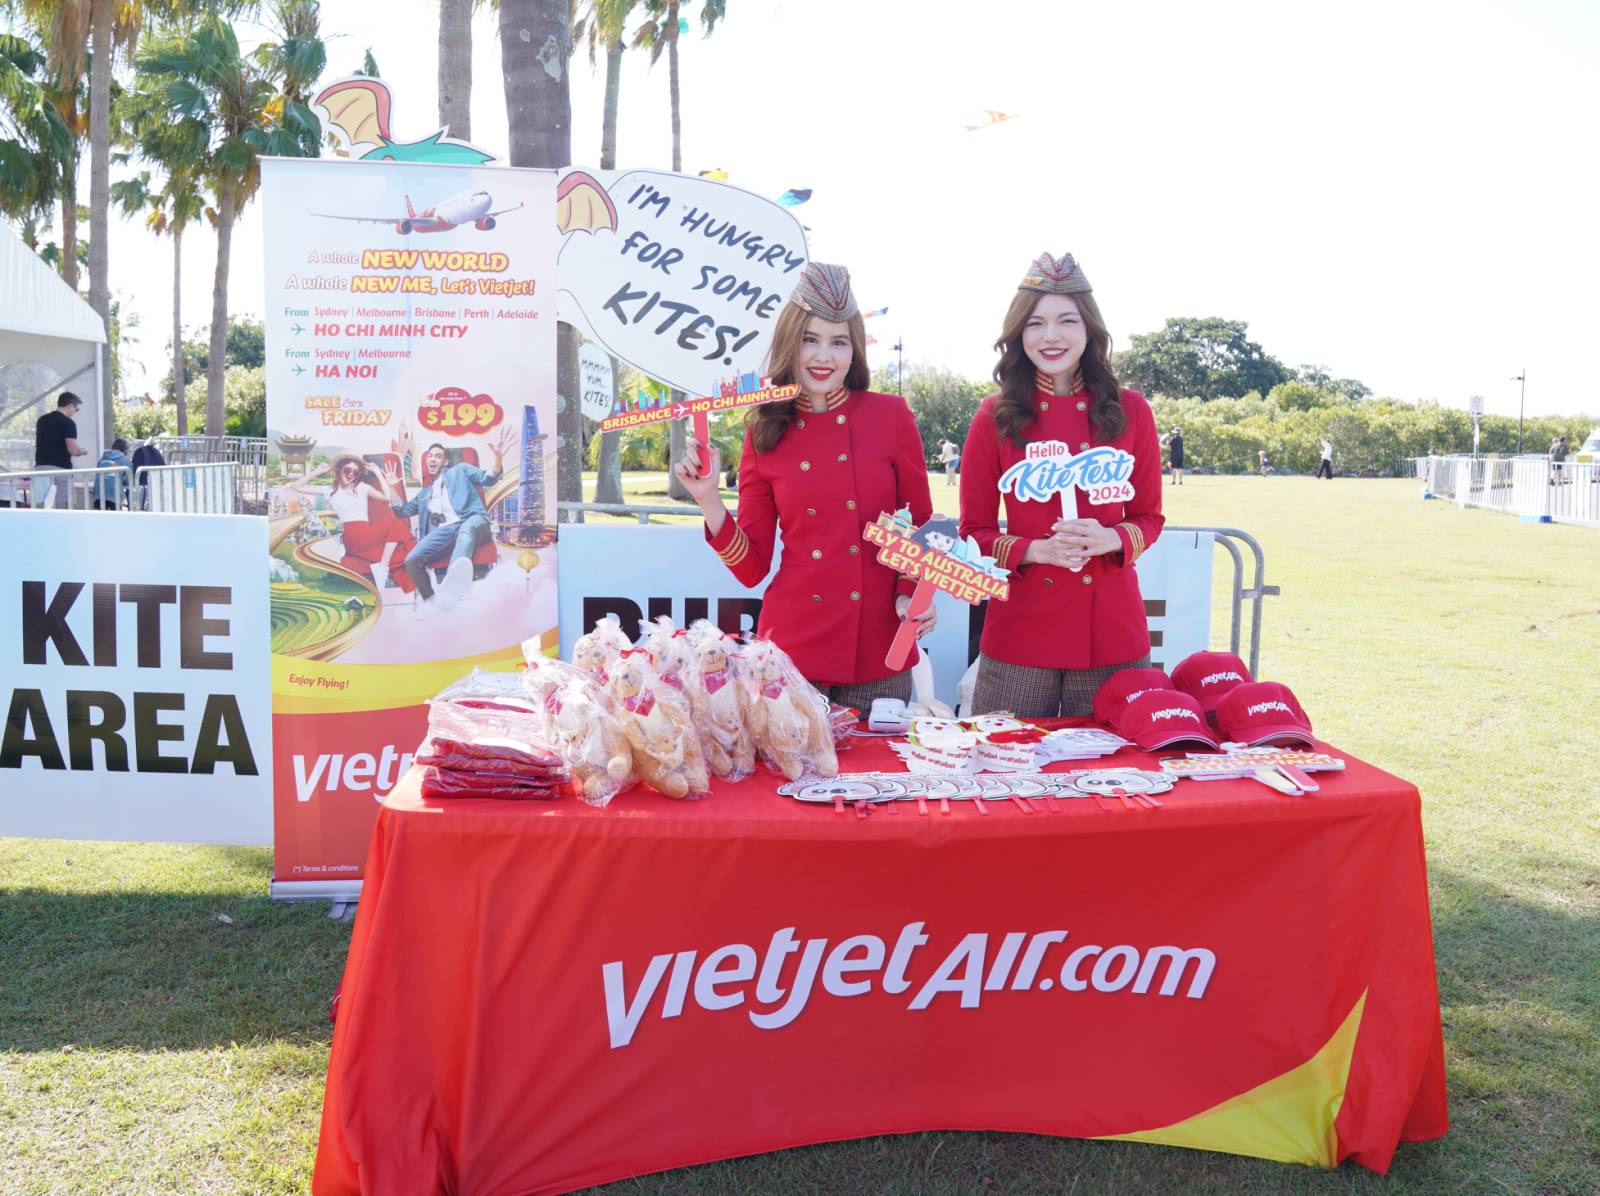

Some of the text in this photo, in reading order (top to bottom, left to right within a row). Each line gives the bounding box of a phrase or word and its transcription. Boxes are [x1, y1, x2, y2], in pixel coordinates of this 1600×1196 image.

[627, 184, 805, 274] I'M HUNGRY
[308, 249, 510, 272] A whole NEW WORLD
[286, 274, 536, 298] A whole NEW ME, Let's Vietjet!
[621, 231, 781, 319] FOR SOME
[284, 307, 539, 320] From Sydney Melbourne Brisbane Perth Adelaide
[603, 282, 759, 366] KITES!
[314, 324, 468, 338] HO CHI MINH CITY
[285, 348, 411, 361] From Sydney Melbourne
[315, 365, 378, 378] HA NOI
[304, 395, 341, 409] SALE
[692, 400, 710, 413] HO
[712, 397, 734, 409] CHI
[735, 391, 770, 406] MINH
[772, 384, 800, 399] CITY
[321, 409, 392, 426] FRIDAY
[1029, 443, 1065, 459] Hello
[1001, 449, 1131, 499] Kite Fest
[1092, 485, 1131, 501] 2024
[866, 524, 1010, 600] FLY TO AUSTRALIA
[880, 548, 987, 604] LET'S VIETJET
[22, 580, 233, 670] KITE
[289, 673, 315, 687] Enjoy
[0, 688, 259, 776] AREA
